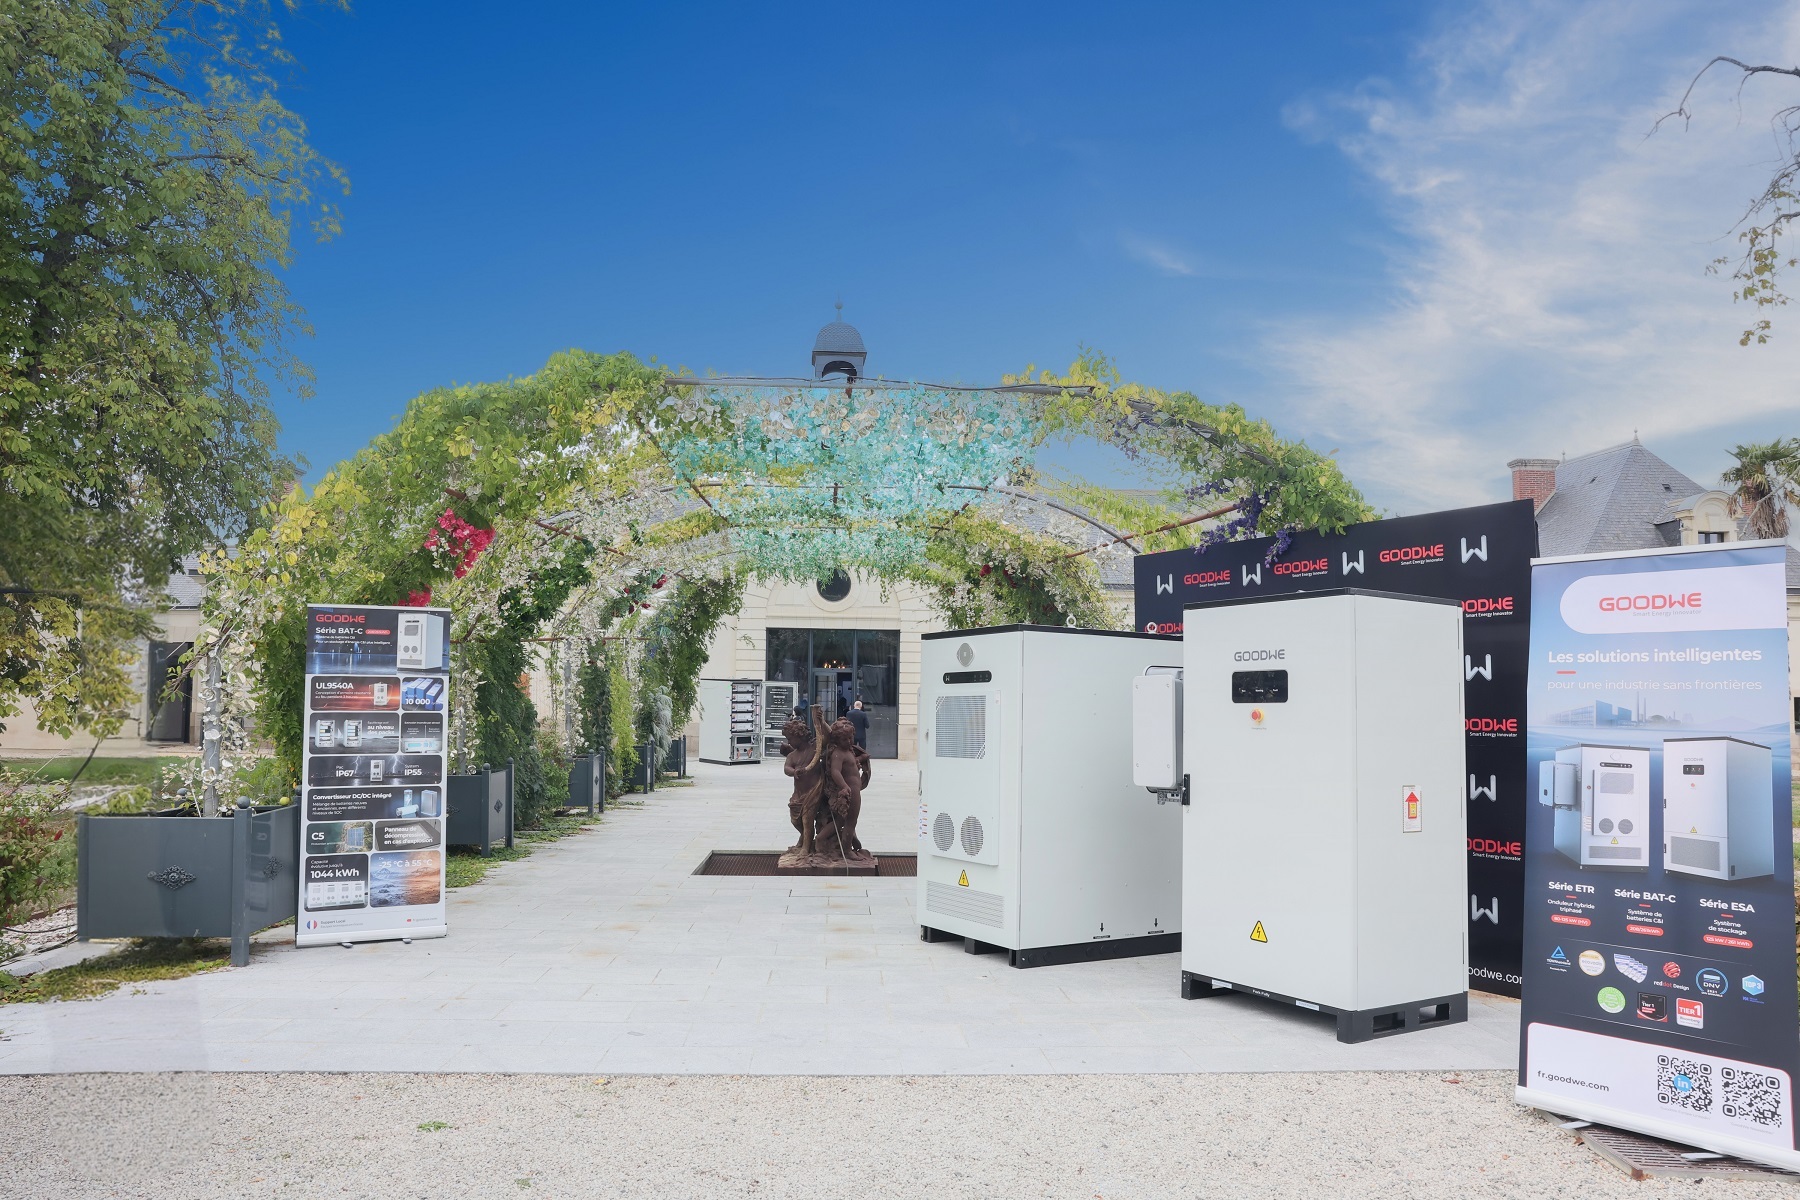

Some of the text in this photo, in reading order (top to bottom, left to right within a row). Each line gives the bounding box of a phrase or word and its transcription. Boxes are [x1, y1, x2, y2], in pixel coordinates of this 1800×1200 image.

[1379, 544, 1444, 563] GOODWE
[1273, 557, 1328, 575] GOODWE
[1183, 569, 1231, 585] GOODWE
[1462, 596, 1514, 613] ODWE
[1599, 592, 1702, 612] GOODWE
[315, 614, 366, 624] GOODWE
[315, 626, 337, 635] Série
[338, 627, 364, 635] BAT-C
[1234, 649, 1286, 662] GOODWE
[1548, 647, 1762, 665] Les solutions intelligentes
[315, 682, 354, 690] UL9540A
[1547, 679, 1762, 691] pour une industrie sans frontières
[1465, 718, 1518, 732] ODWE
[335, 769, 354, 777] IP67
[404, 768, 423, 776] IP55
[372, 792, 392, 800] intégré
[311, 832, 325, 840] C5
[384, 832, 427, 840] décompression
[1467, 837, 1522, 856] ODWE
[1485, 852, 1500, 860] Energy
[1500, 854, 1521, 862] Innovator
[405, 859, 410, 867] à
[310, 868, 360, 879] 1044 kWh
[1548, 881, 1595, 894] Série ETR
[1614, 888, 1677, 903] Série BAT-C
[1547, 899, 1596, 909] Onduleur hybride
[1699, 898, 1756, 913] Série ESA
[1559, 906, 1583, 914] triphasé
[1627, 908, 1653, 916] Système
[1626, 914, 1653, 923] batteries
[1713, 919, 1742, 928] Système
[1717, 926, 1748, 936] stockage
[1673, 983, 1690, 991] Design
[1744, 980, 1756, 988] TOP
[1537, 1070, 1610, 1092] fr.goodwe.com
